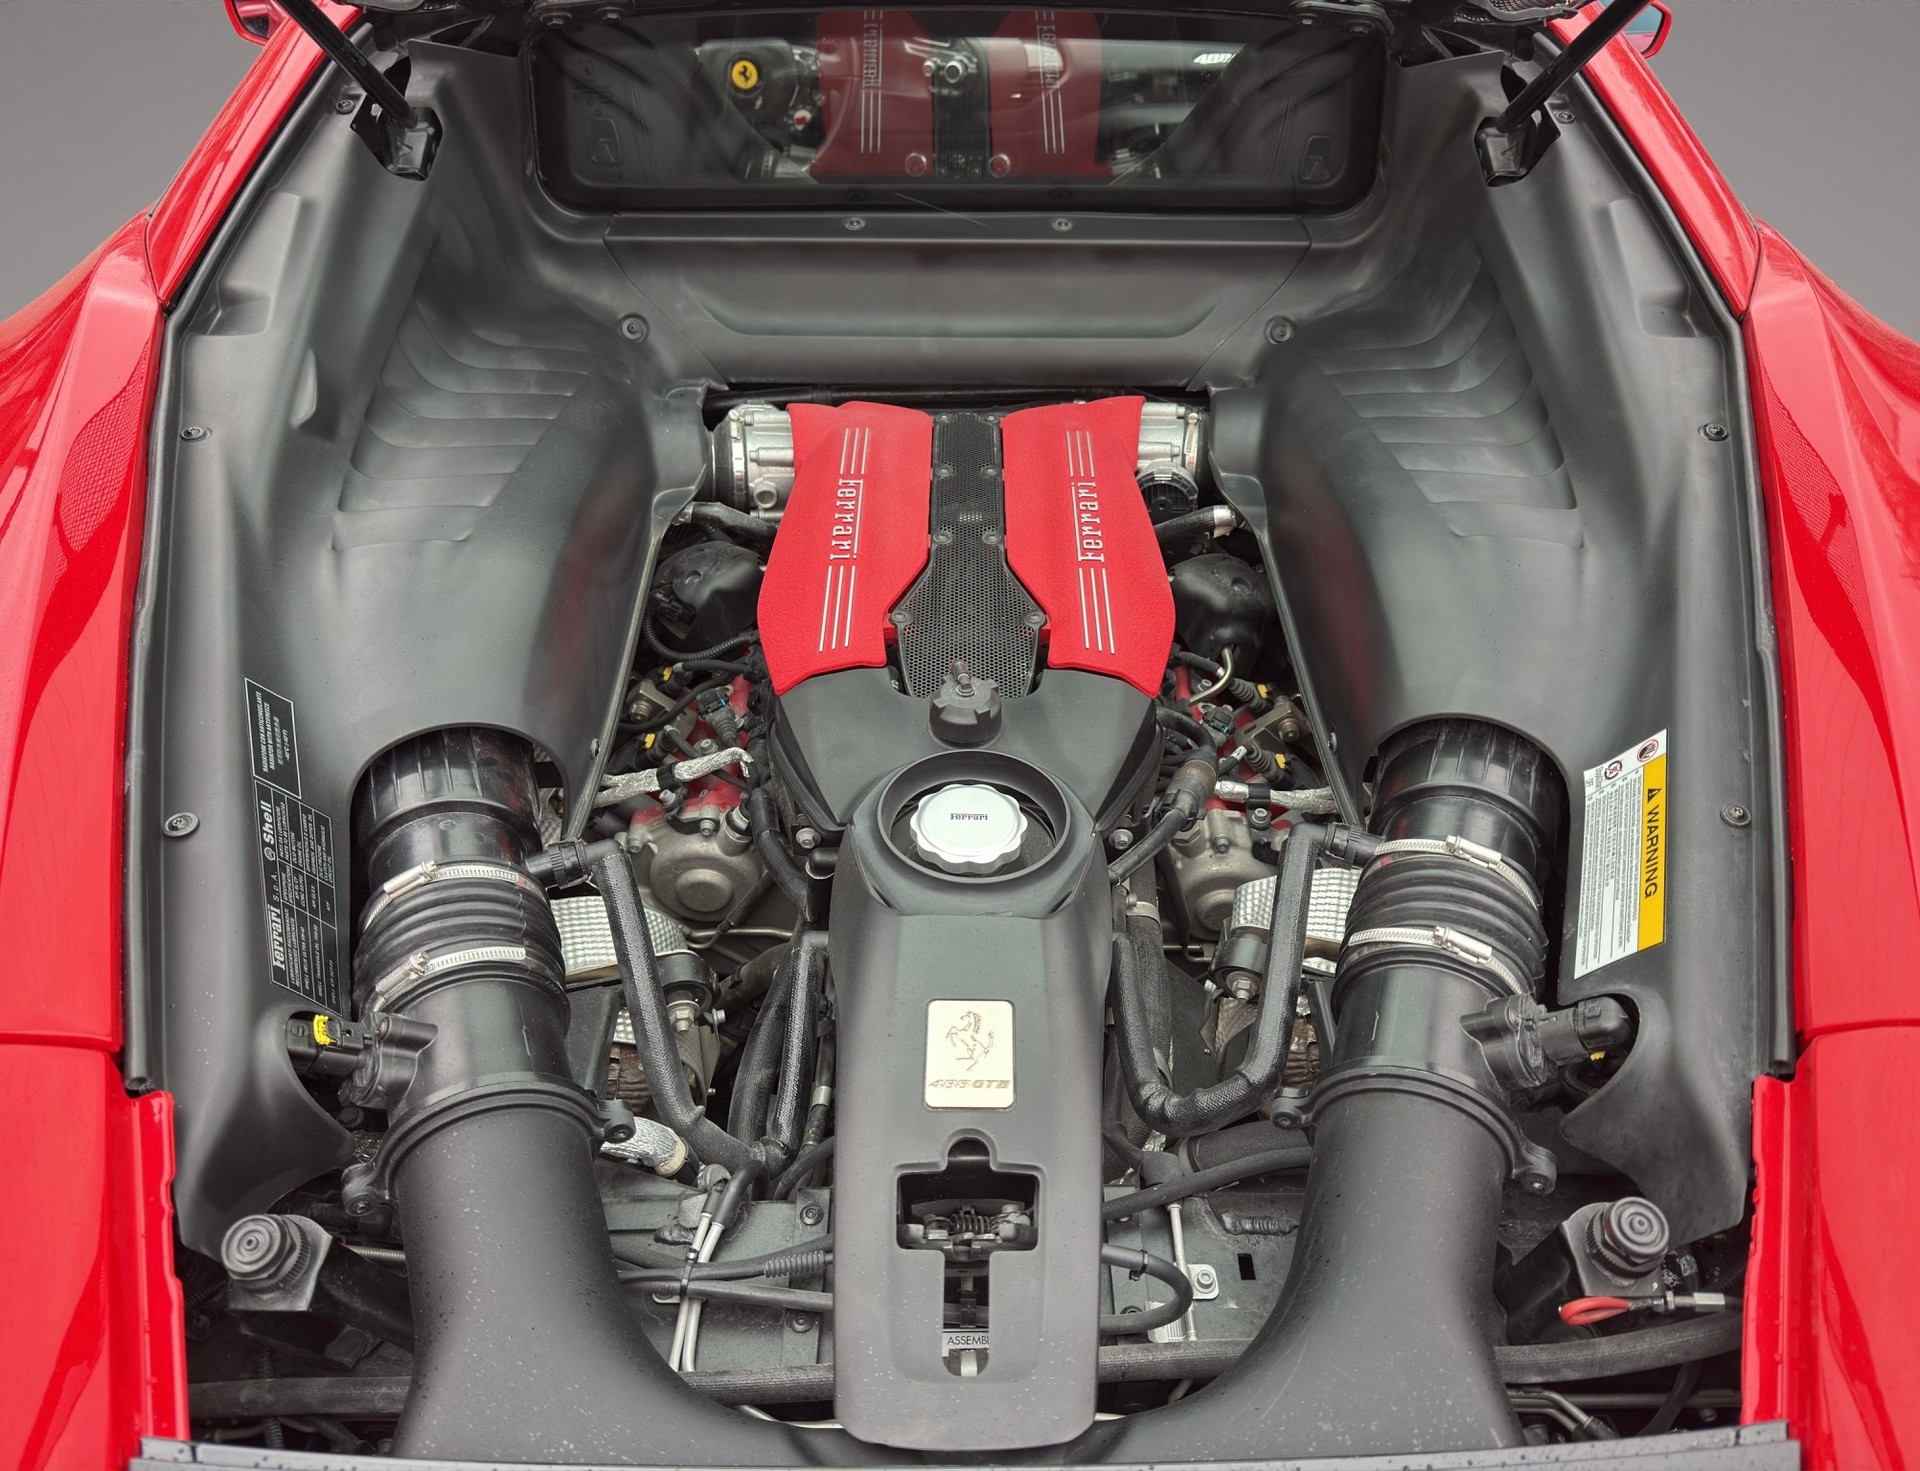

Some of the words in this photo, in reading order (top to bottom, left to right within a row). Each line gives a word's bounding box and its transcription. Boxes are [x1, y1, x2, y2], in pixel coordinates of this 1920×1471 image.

[829, 478, 864, 561] Ferrari
[1070, 481, 1105, 563] Ferrari
[256, 691, 264, 734] ANTICONGELANTE
[264, 702, 272, 732] ANTIFREEZE
[260, 800, 275, 845] Shell
[950, 813, 988, 821] Ferrari
[1645, 805, 1660, 899] WARNING
[268, 904, 285, 970] Ferrari
[928, 1079, 971, 1089] 488
[971, 1079, 1011, 1089] GTB
